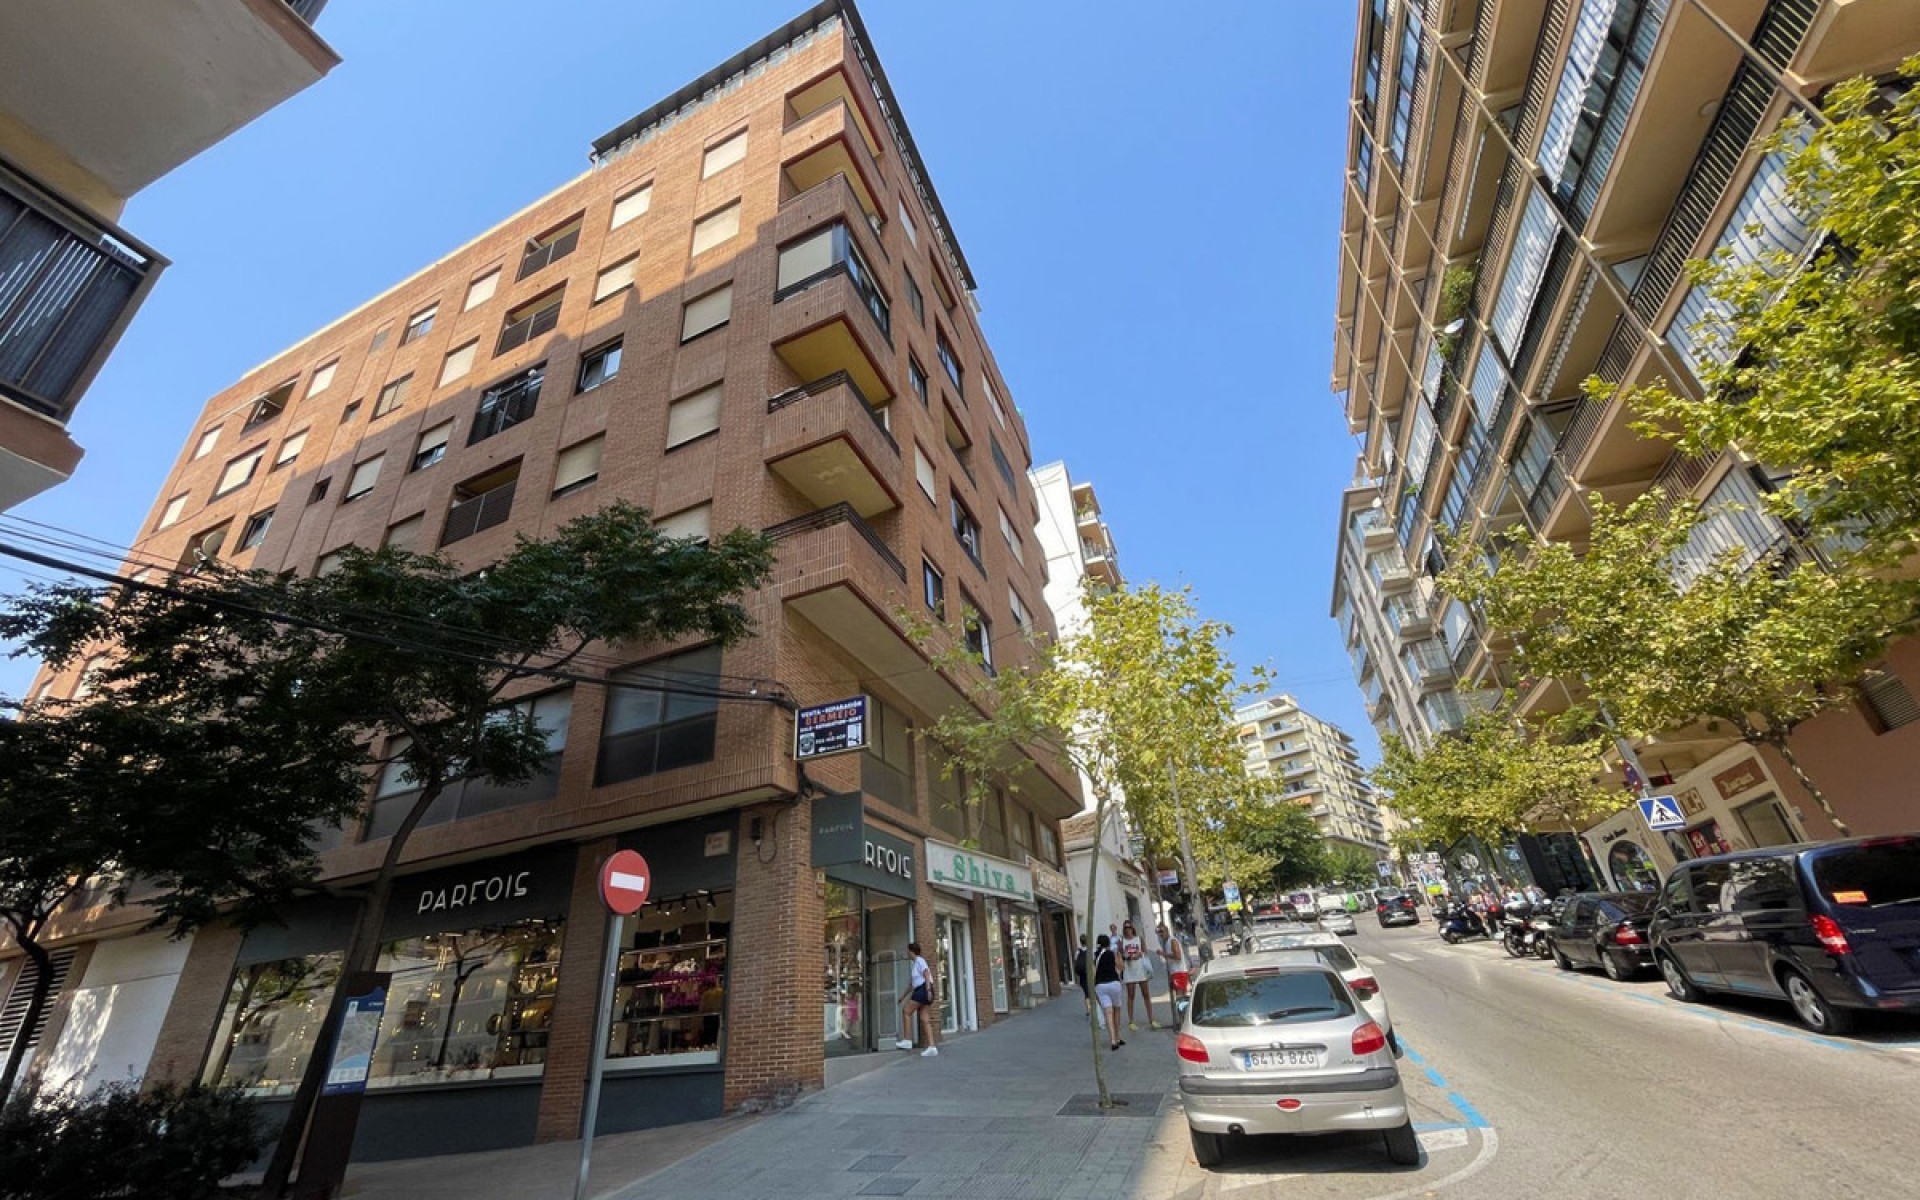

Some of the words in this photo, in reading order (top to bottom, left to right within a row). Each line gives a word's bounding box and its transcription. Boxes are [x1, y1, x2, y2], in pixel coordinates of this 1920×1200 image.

[865, 840, 912, 879] RFOIS
[952, 853, 1015, 892] Shiva
[417, 871, 531, 914] PARFOIS
